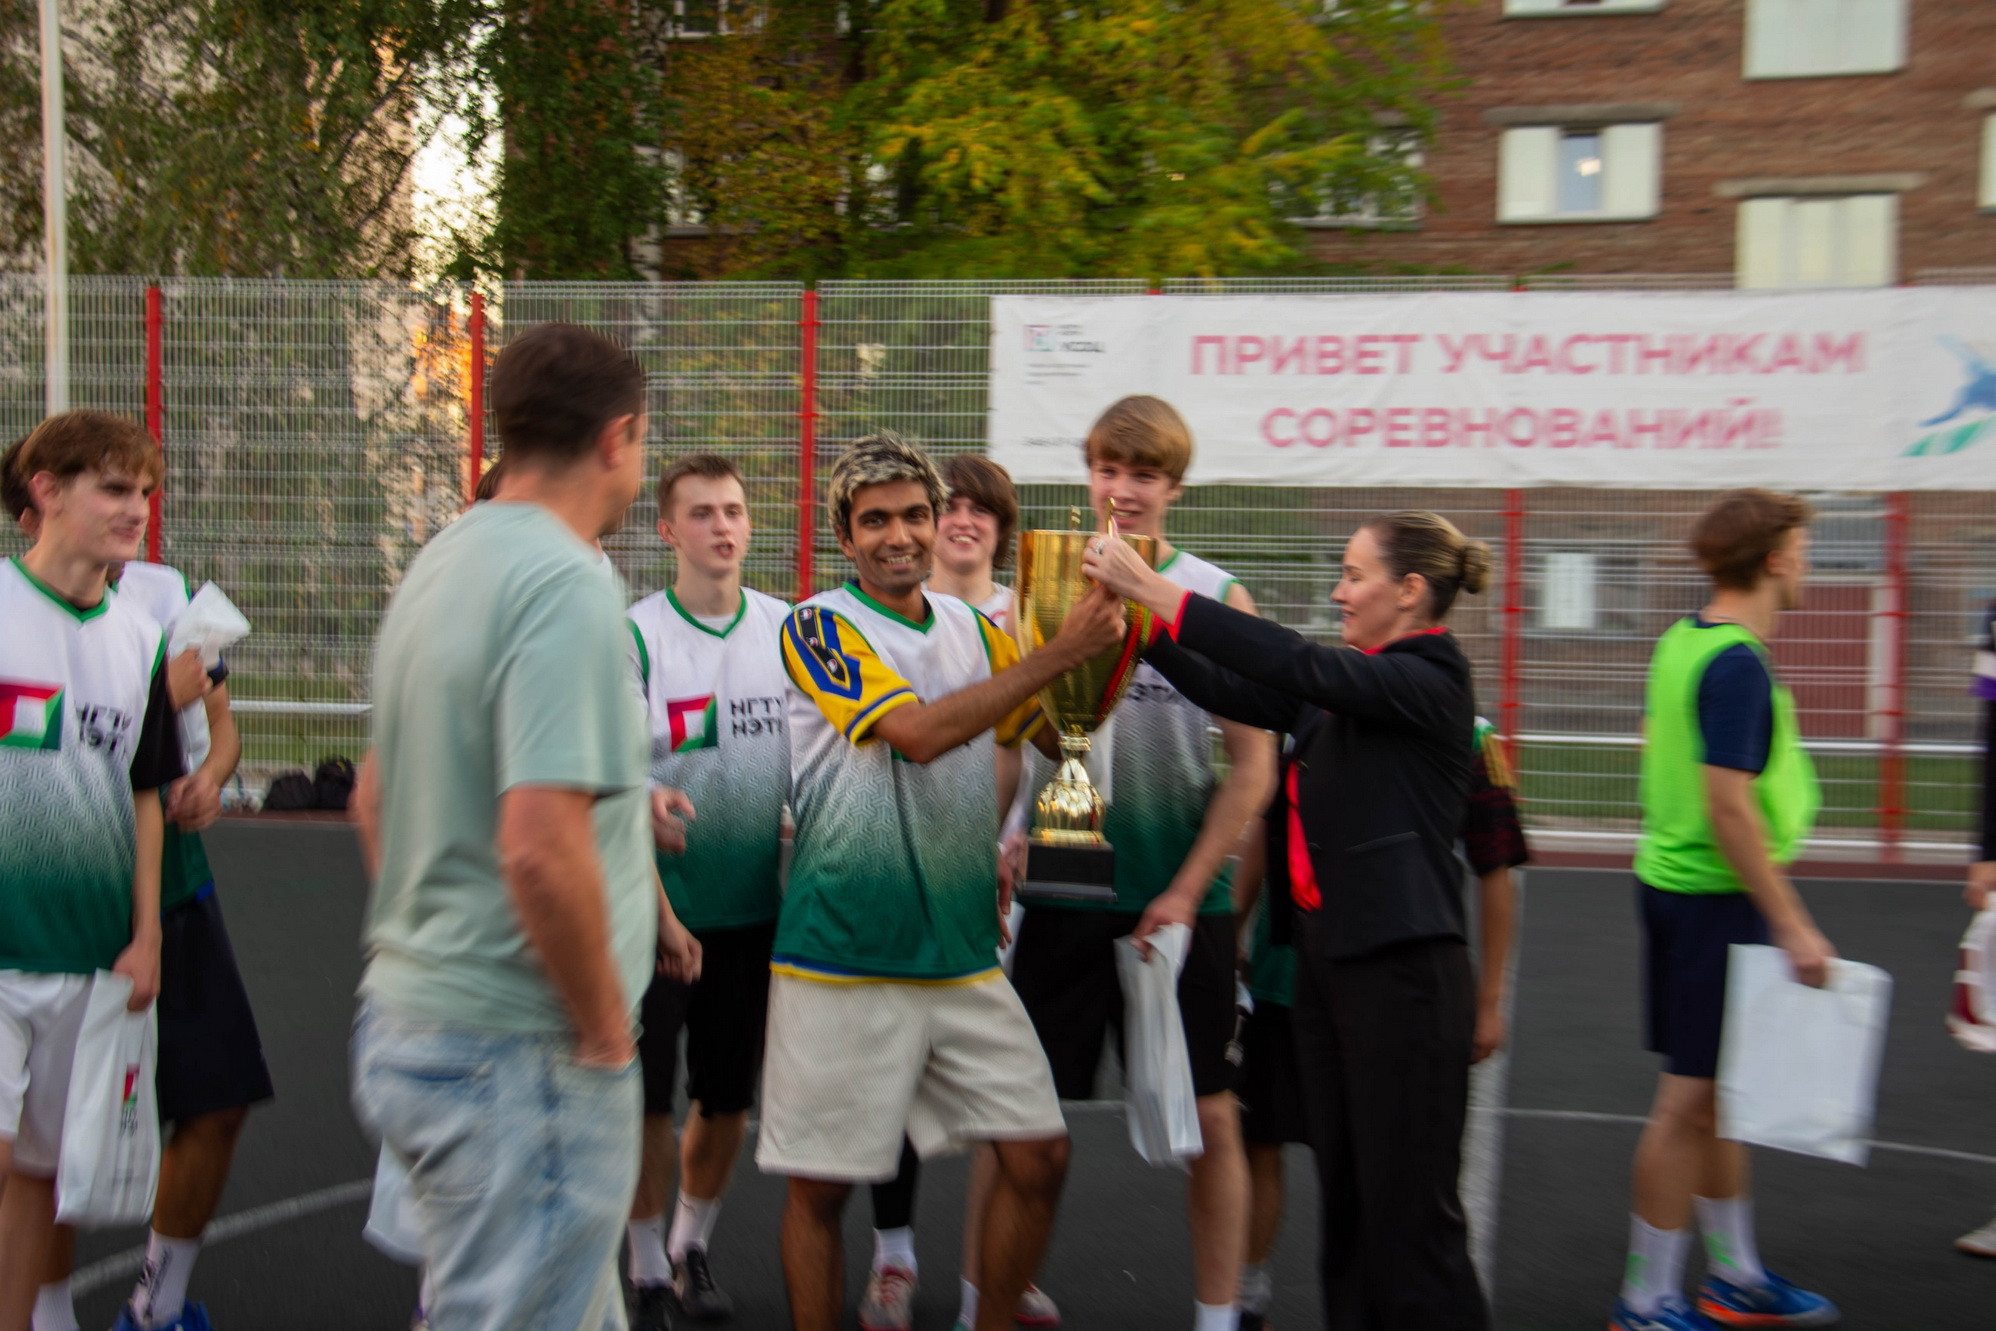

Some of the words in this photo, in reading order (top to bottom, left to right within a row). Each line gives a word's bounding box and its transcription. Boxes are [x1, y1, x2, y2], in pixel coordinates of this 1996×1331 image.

[1190, 334, 1420, 376] ПРИВЕТ
[1435, 332, 1866, 375] УЧАСТНИКАМ
[1260, 398, 1781, 450] СОРЕВНОВАНИЙ!
